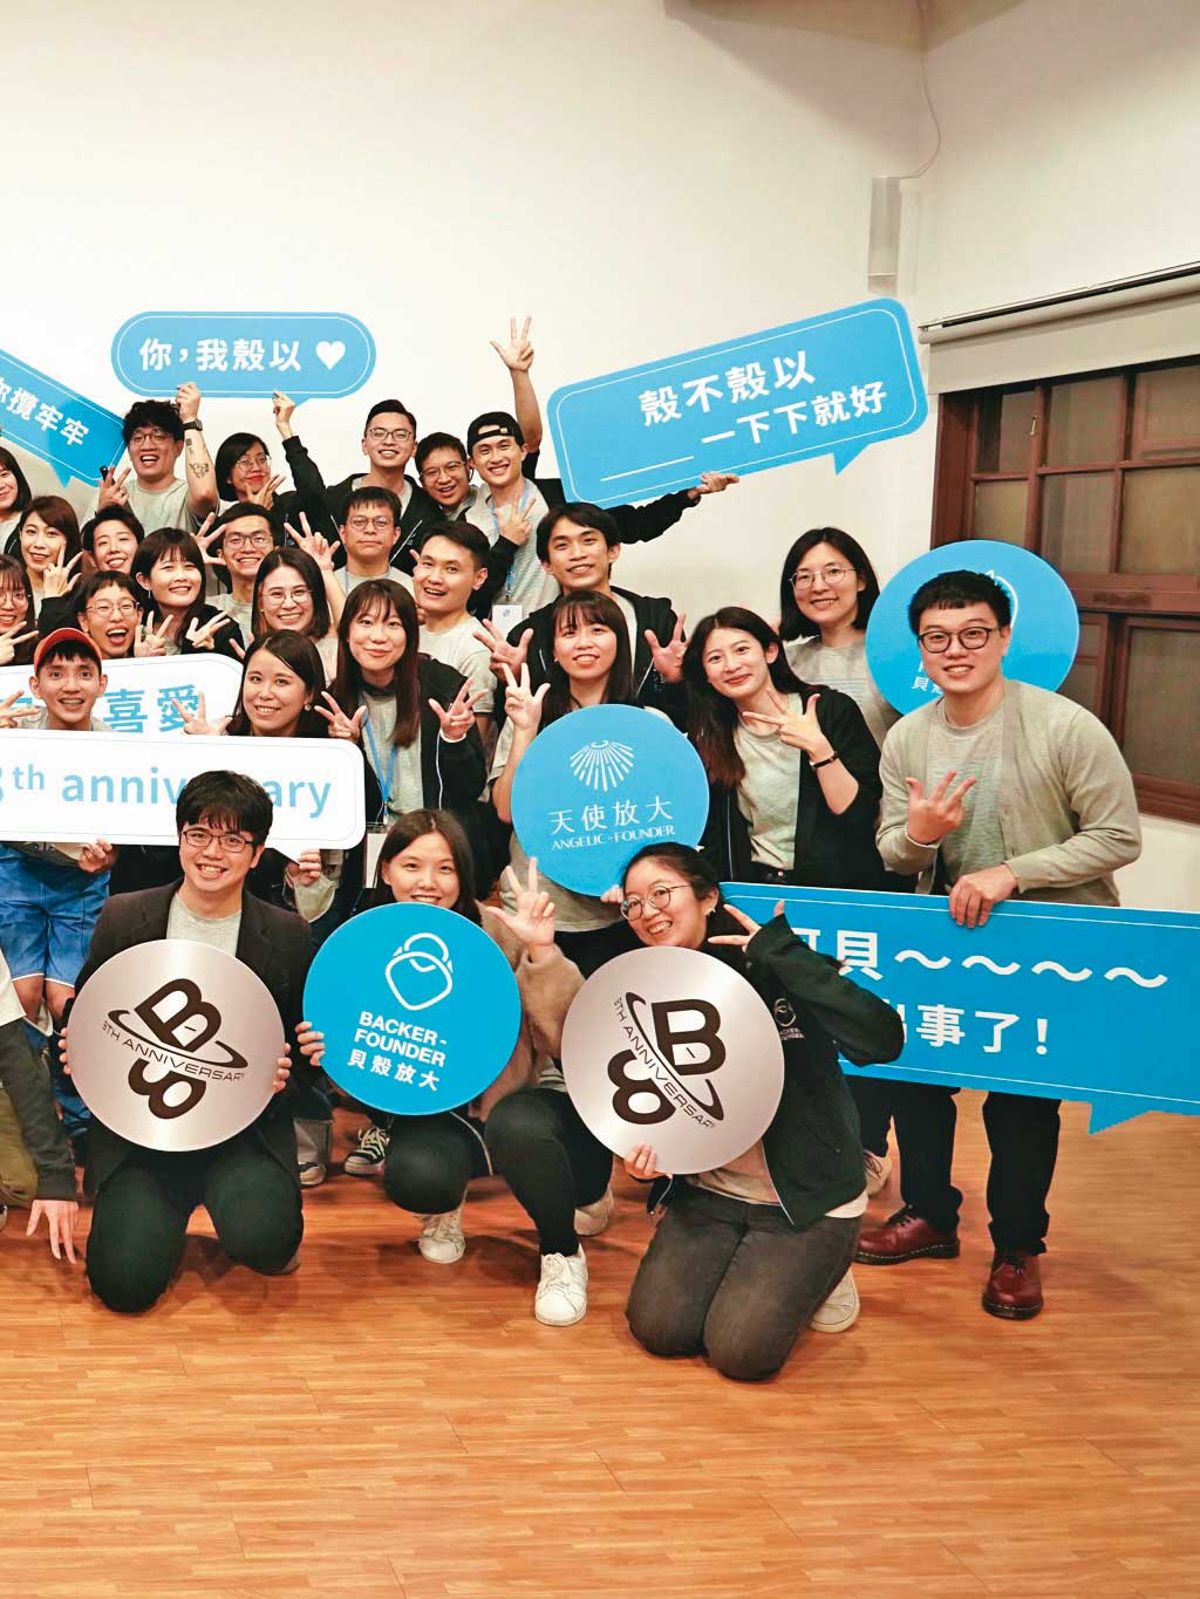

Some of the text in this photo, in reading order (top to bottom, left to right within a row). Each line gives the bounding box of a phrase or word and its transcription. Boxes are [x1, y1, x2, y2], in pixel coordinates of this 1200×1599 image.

[638, 351, 816, 427] 殼不殼以
[701, 381, 888, 444] 一下下就好
[62, 766, 332, 818] annivary
[548, 795, 673, 836] 天使放大
[354, 1028, 446, 1068] FOUNDER
[883, 998, 1049, 1055] 事了！
[347, 1048, 440, 1091] 貝殼放大
